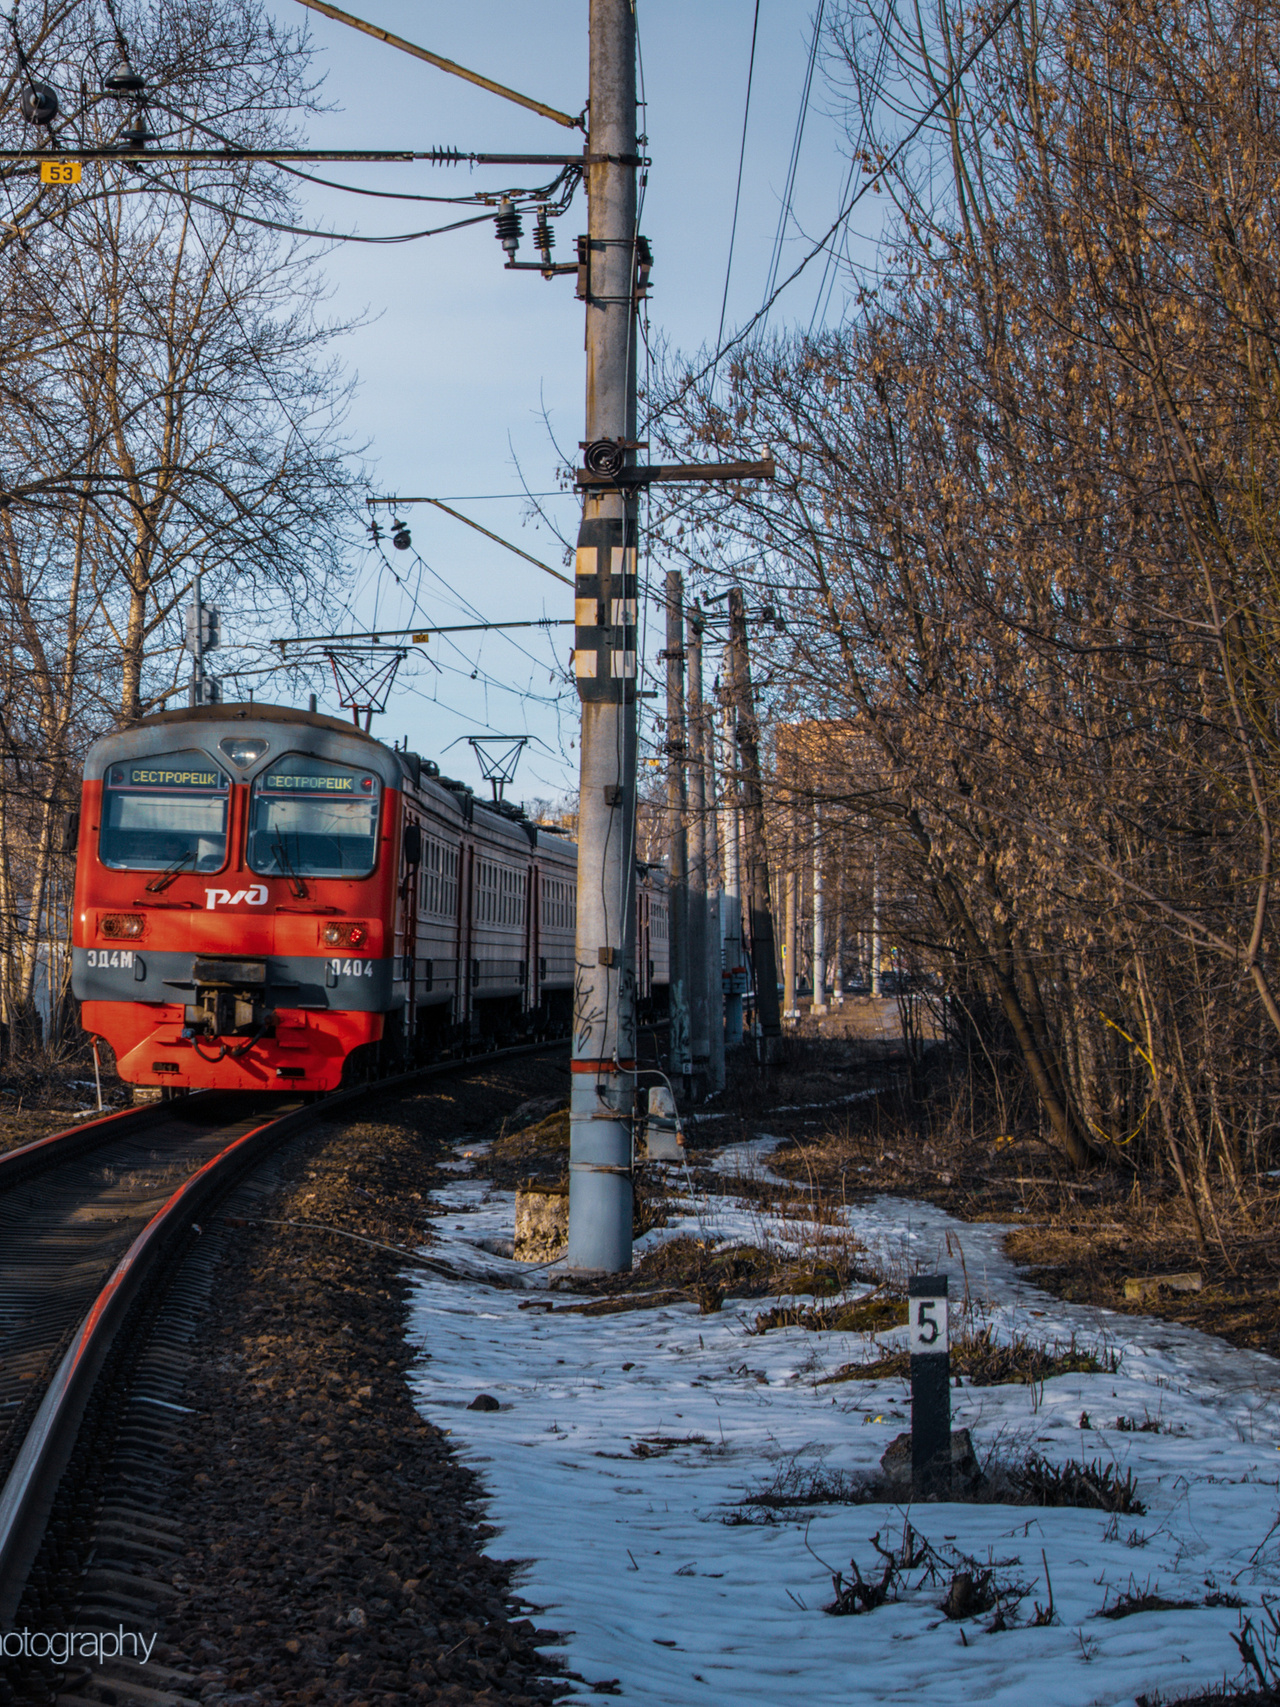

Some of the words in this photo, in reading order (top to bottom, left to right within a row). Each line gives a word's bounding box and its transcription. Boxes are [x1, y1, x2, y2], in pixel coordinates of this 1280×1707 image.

[50, 166, 73, 181] 53
[132, 770, 217, 785] СЕСТРОРЕЦК
[267, 775, 352, 790] СЕСТРОРЕЦК
[87, 950, 133, 968] ЭД4М
[331, 958, 373, 977] 0404
[918, 1301, 938, 1344] 5
